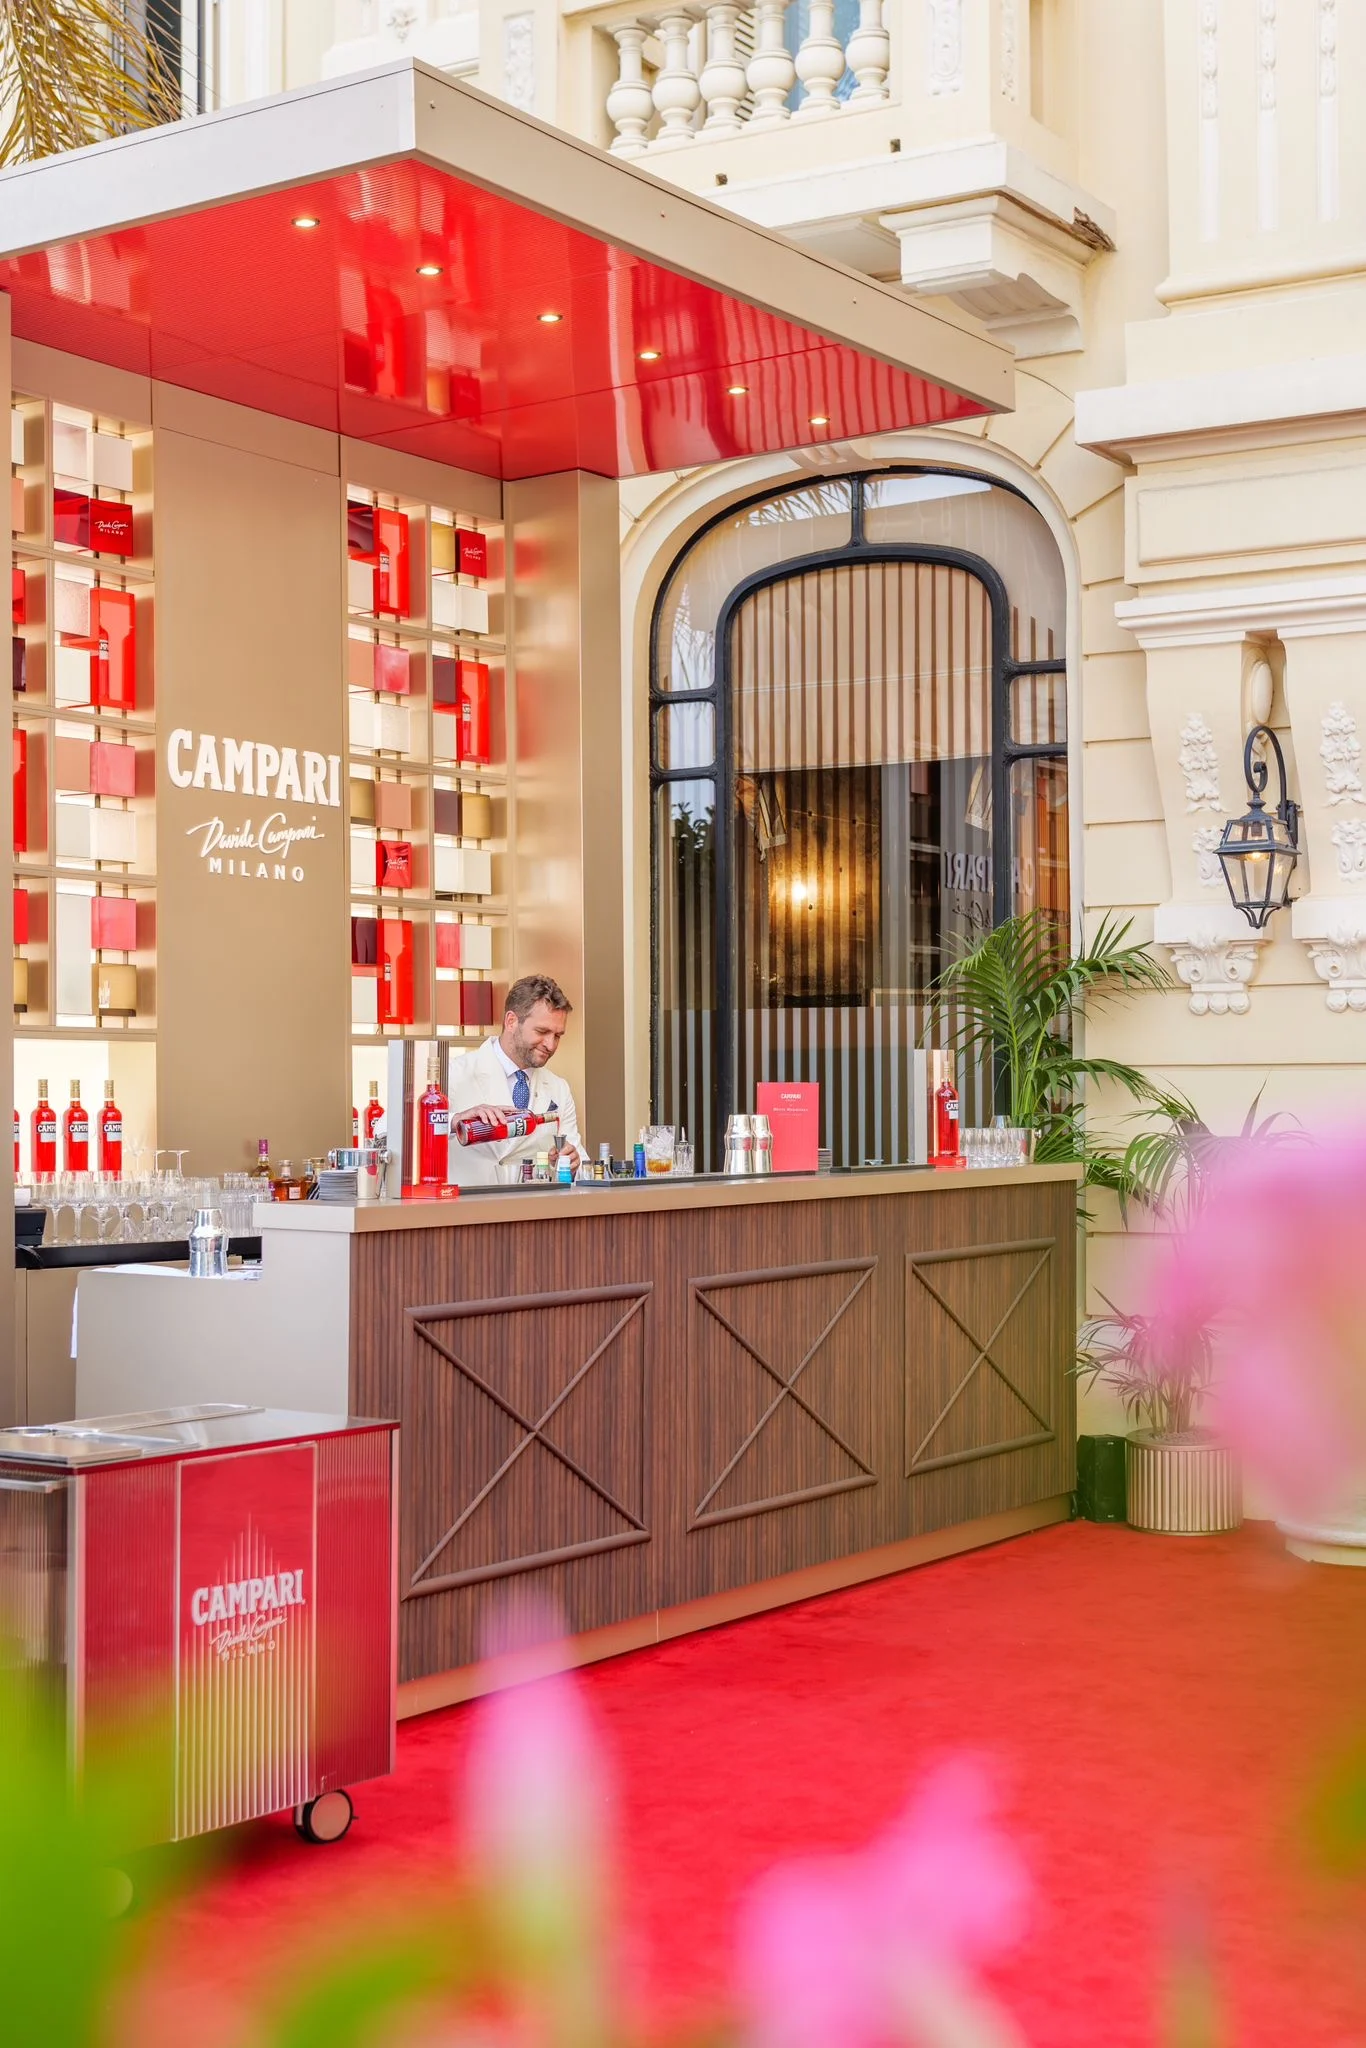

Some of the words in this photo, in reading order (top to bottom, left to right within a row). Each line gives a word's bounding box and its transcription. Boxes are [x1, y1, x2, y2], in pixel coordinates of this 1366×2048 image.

[167, 728, 341, 808] CAMPARI
[186, 816, 259, 858] Davide
[258, 812, 325, 859] Campari
[209, 857, 304, 882] MILANO
[191, 1569, 304, 1626] CAMPARI
